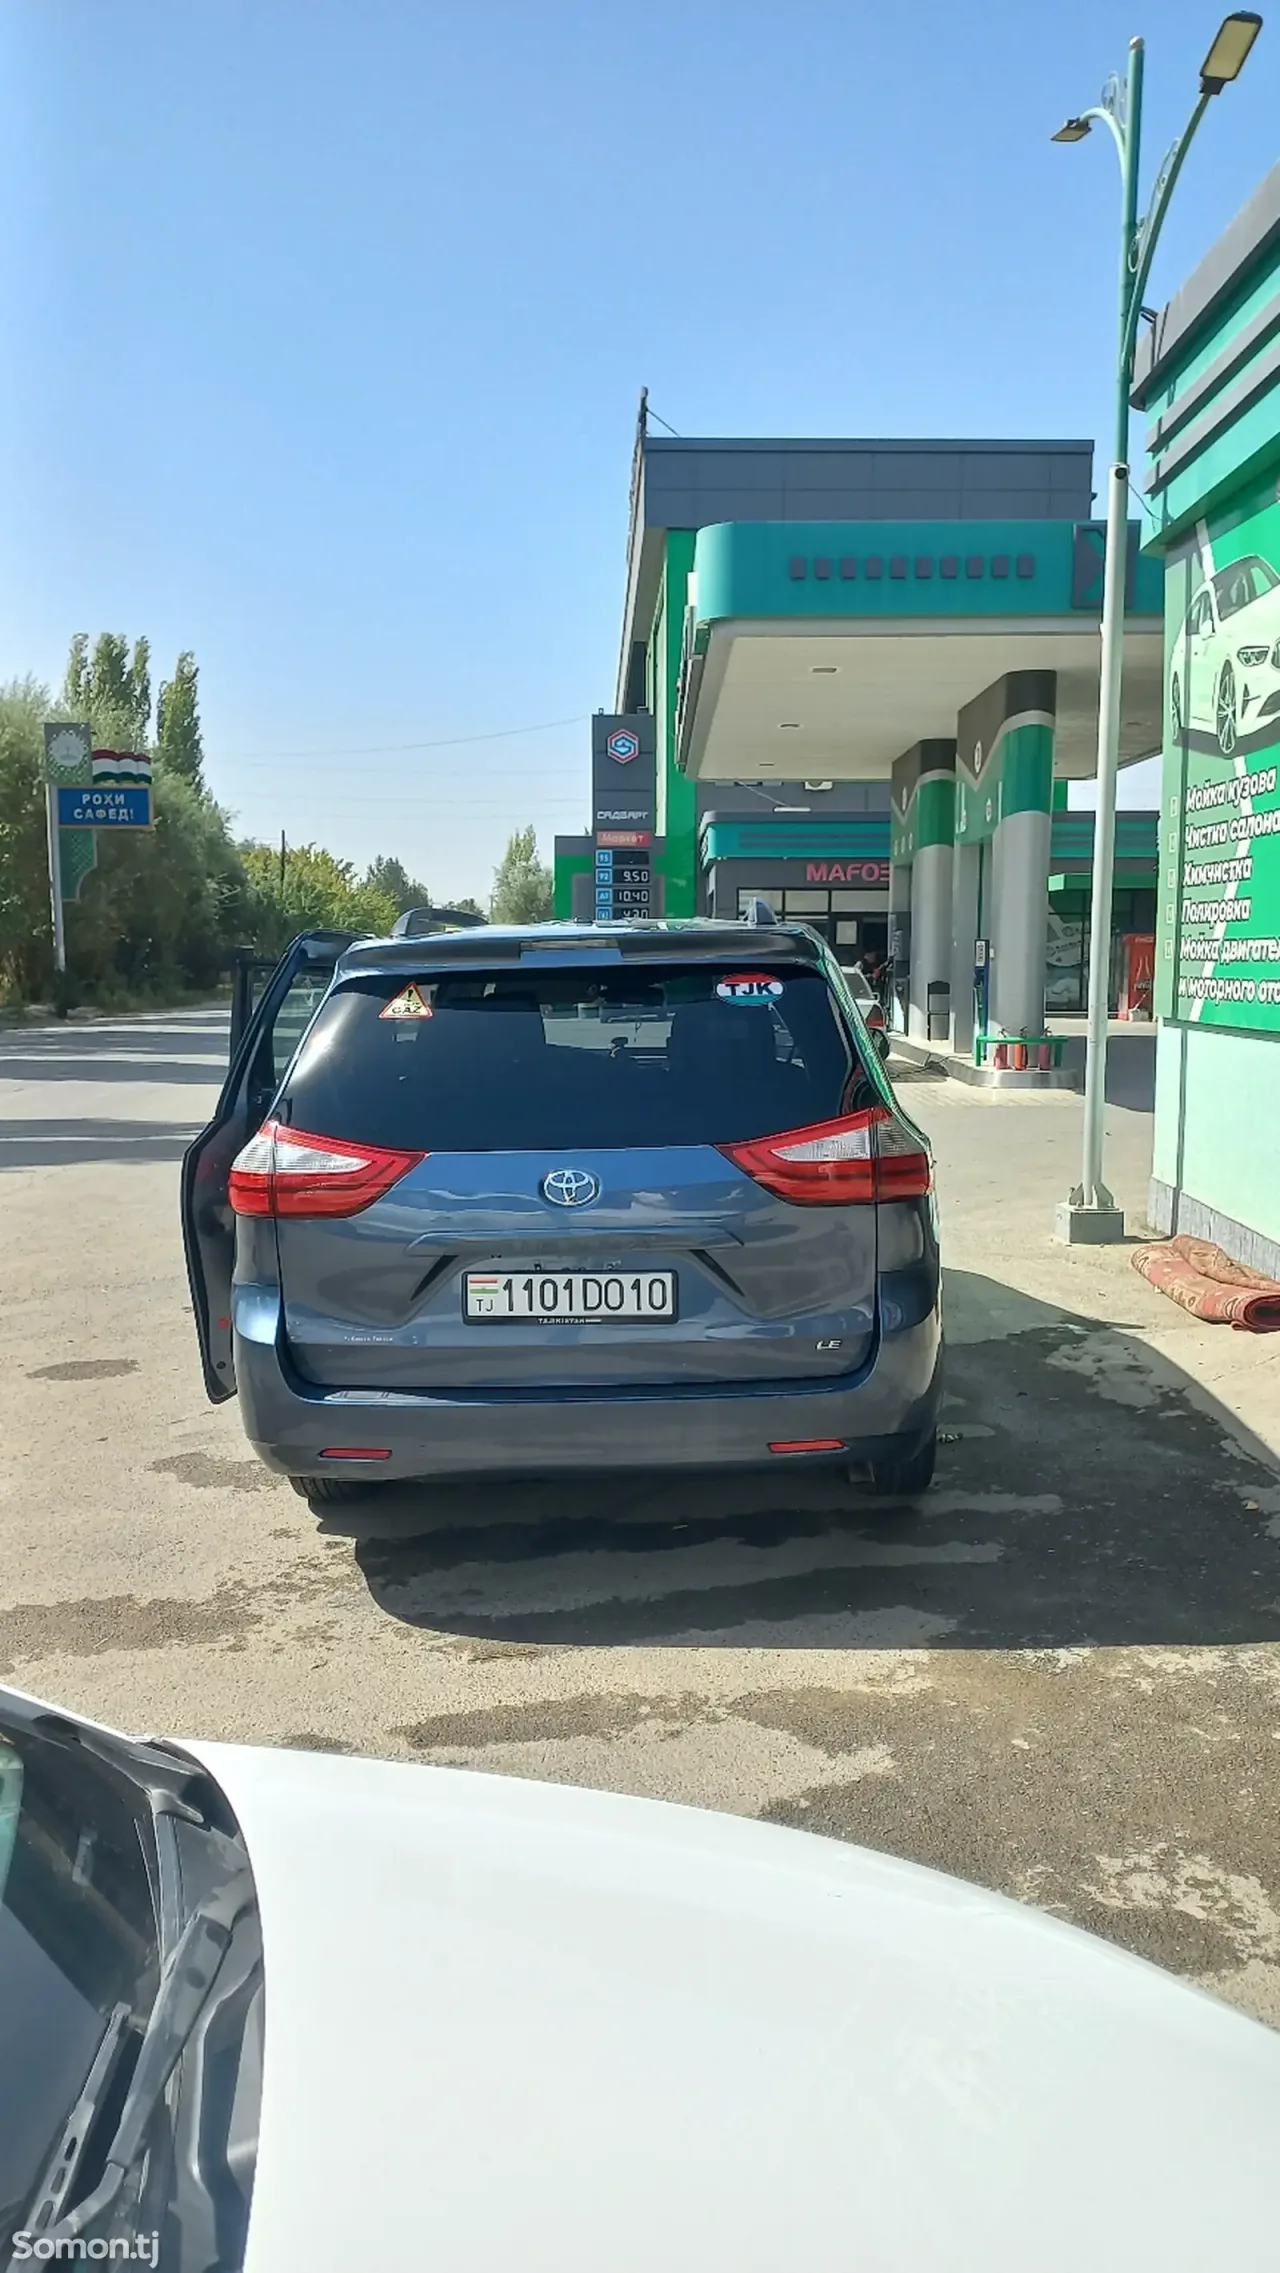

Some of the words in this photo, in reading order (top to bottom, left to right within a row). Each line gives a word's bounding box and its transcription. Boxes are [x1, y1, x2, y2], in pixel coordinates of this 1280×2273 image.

[1185, 779, 1226, 814] Мойка
[1227, 766, 1277, 808] кузова
[73, 808, 134, 821] САФЕД!
[1184, 821, 1229, 850] Чистка
[1182, 856, 1253, 888] Химчистка
[1181, 897, 1252, 929] Полировка
[1180, 932, 1220, 961] Мойка
[725, 982, 774, 996] TJK
[1178, 976, 1187, 997] и
[1187, 976, 1256, 1006] моторного
[476, 1299, 494, 1312] TJ
[502, 1278, 667, 1311] 1101DO10
[816, 1339, 841, 1350] LE
